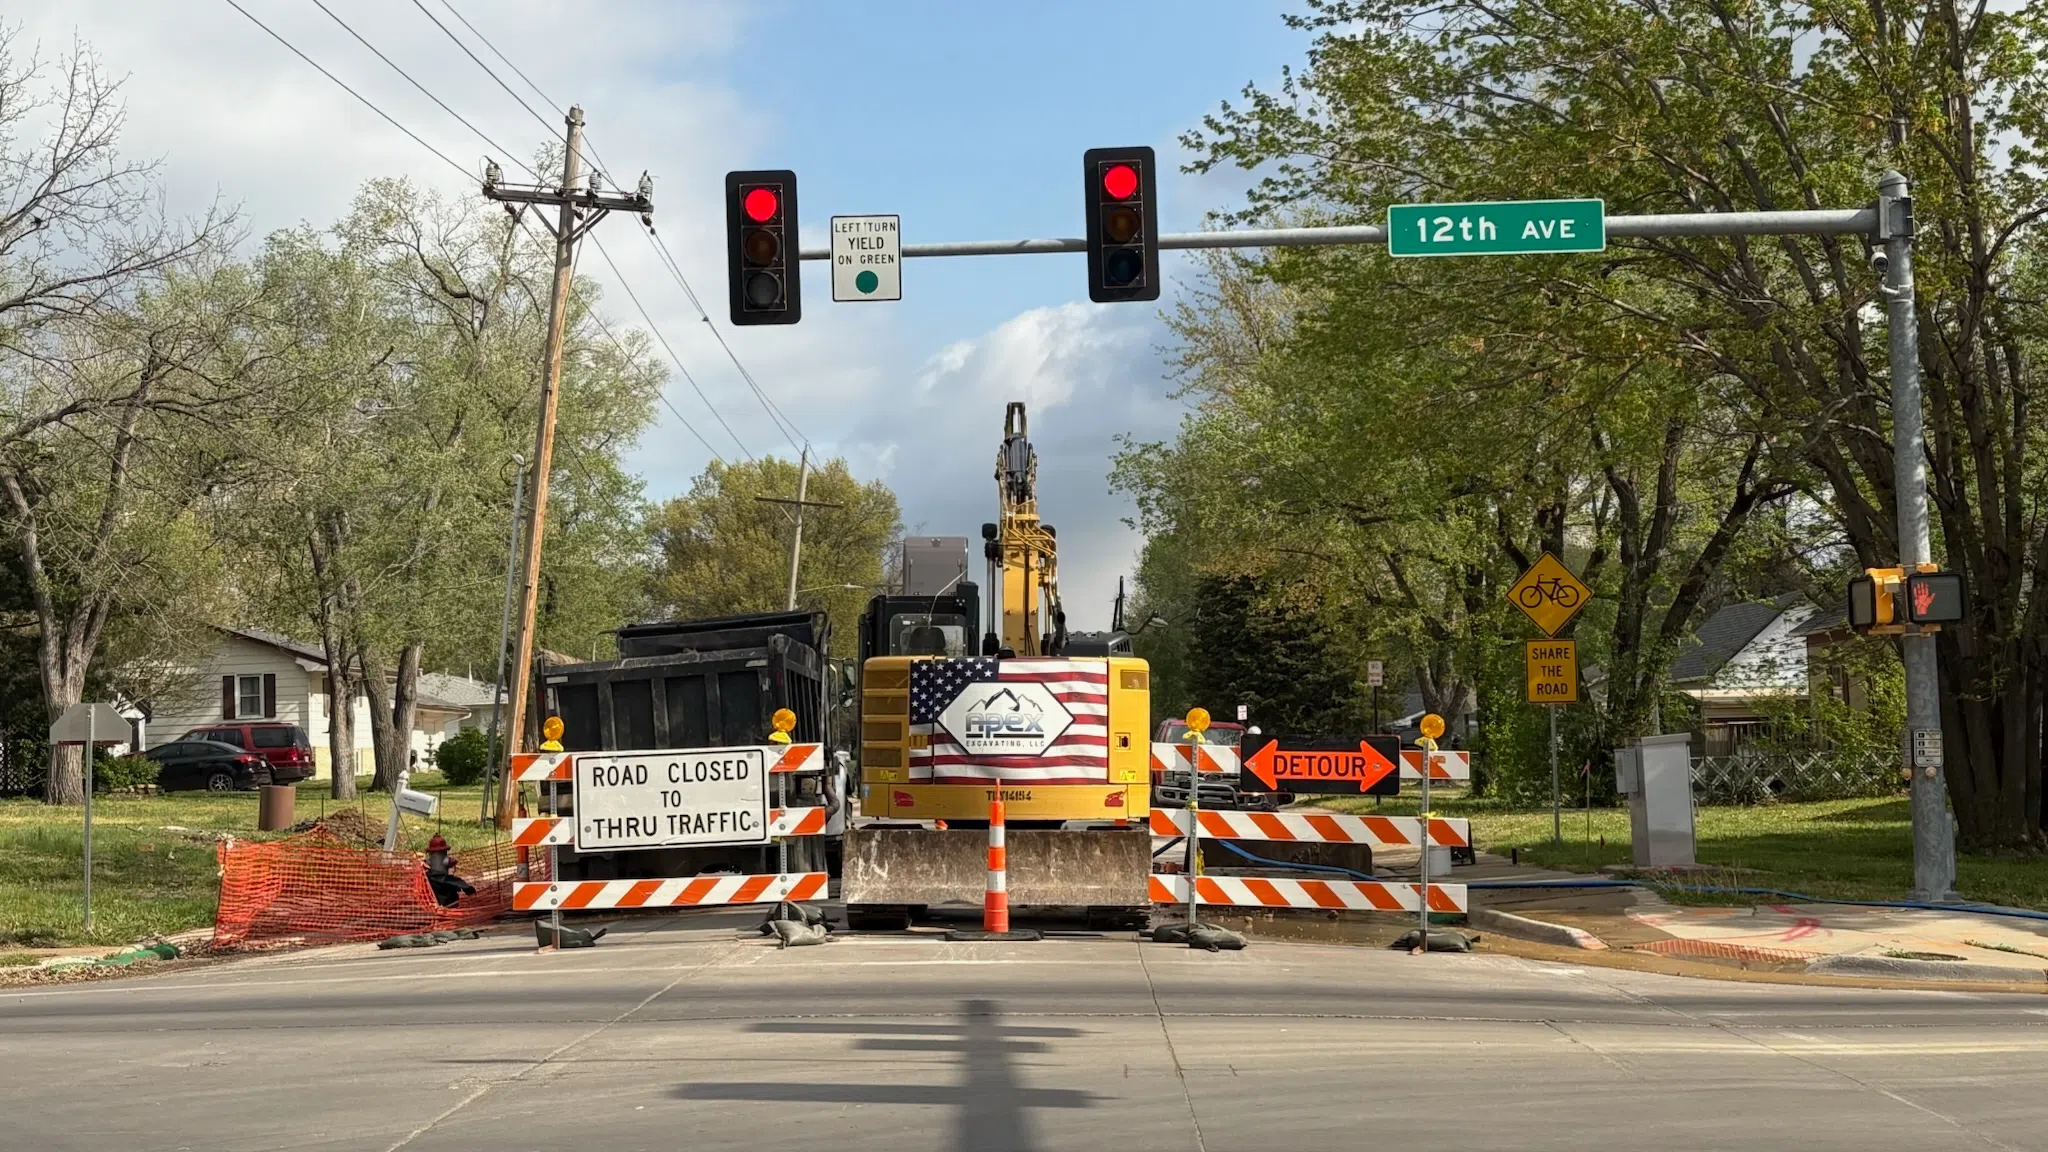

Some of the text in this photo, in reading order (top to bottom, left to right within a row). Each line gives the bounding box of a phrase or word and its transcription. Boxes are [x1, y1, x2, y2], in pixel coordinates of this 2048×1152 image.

[835, 221, 896, 233] LEFT TURN
[1417, 215, 1576, 242] 12th AVE
[848, 236, 884, 250] YIELD
[838, 254, 894, 265] ON GREEN
[1532, 648, 1570, 660] SHARE
[1541, 666, 1563, 677] THE
[1537, 683, 1568, 695] ROAD
[1029, 740, 1045, 748] LLC
[1273, 755, 1366, 777] DETOUR
[592, 759, 749, 787] ROAD CLOSED
[660, 790, 681, 808] TO
[593, 810, 751, 839] THRU TRAFFIC
